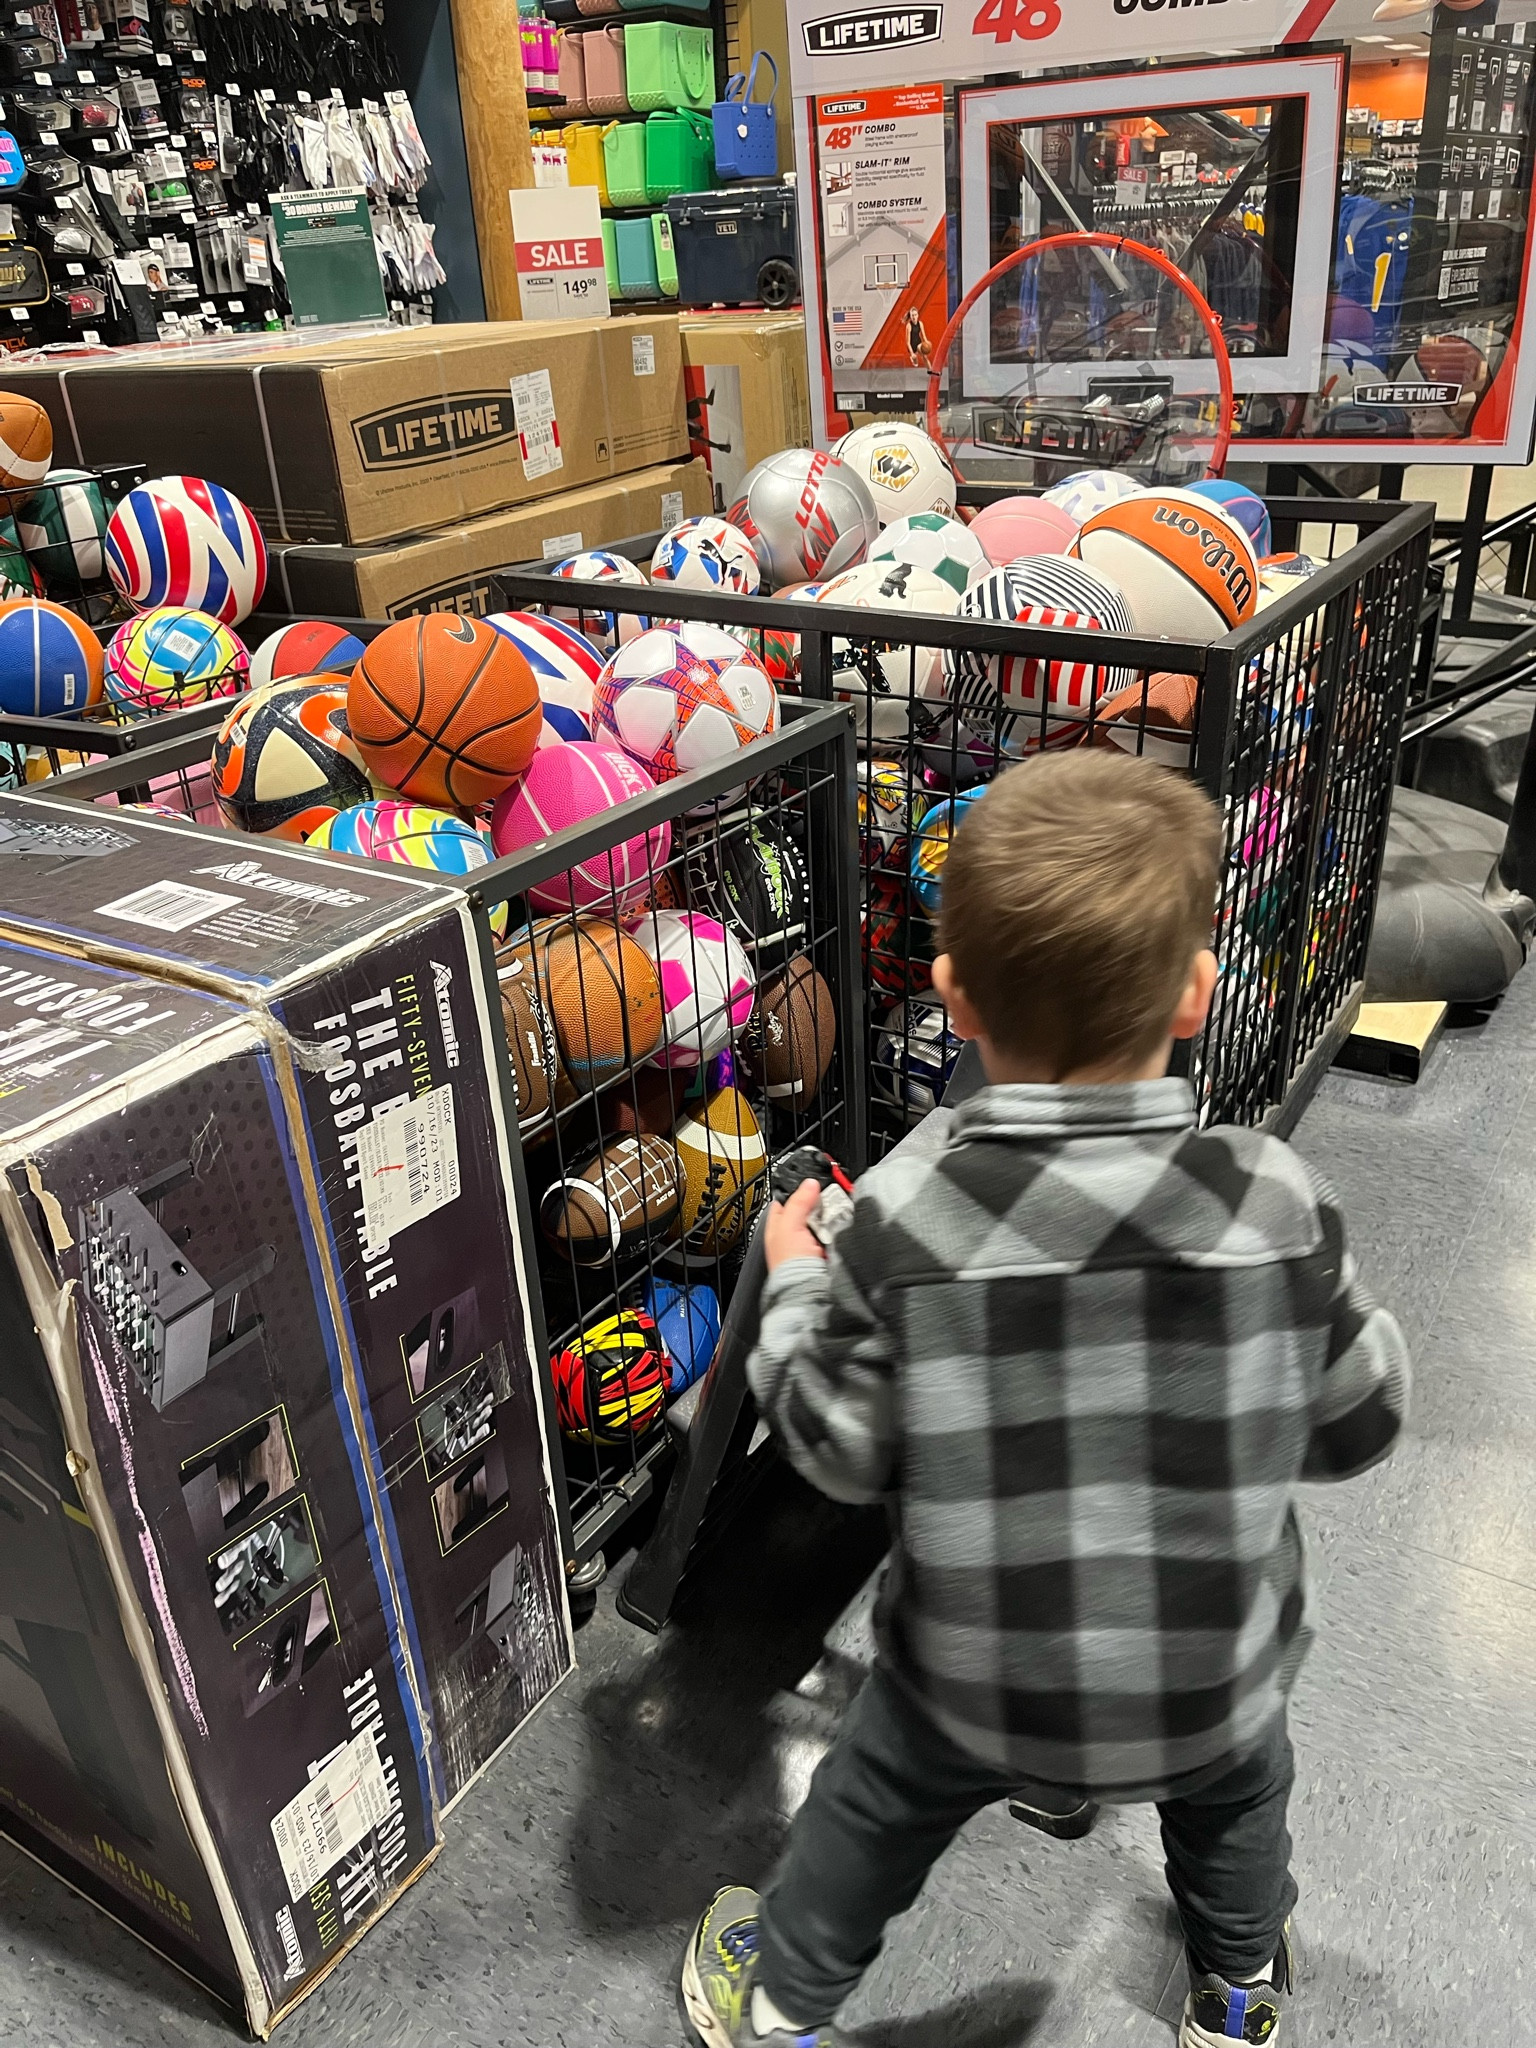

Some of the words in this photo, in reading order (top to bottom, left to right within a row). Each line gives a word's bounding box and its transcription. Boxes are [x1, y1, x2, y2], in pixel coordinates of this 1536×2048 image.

[818, 13, 926, 48] LIFETIME
[827, 102, 862, 113] LIFETIME
[865, 123, 896, 134] COMBO
[893, 156, 910, 166] RIM
[1121, 169, 1144, 182] SALE
[295, 203, 323, 215] BONUS
[857, 200, 888, 209] COMBO
[889, 197, 922, 207] SYSTEM
[718, 223, 736, 233] YETI
[530, 242, 589, 268] SALE
[1364, 386, 1448, 403] LIFETIME
[377, 403, 503, 457] LIFETIME
[794, 450, 829, 530] LOTTO
[1155, 504, 1254, 619] Wilson
[190, 860, 371, 908] Atomic
[350, 986, 404, 1079] THE
[429, 959, 460, 1069] Atomic
[426, 1094, 439, 1154] 10/16/23
[441, 1089, 452, 1125] XDOCK
[448, 1159, 459, 1196] 00024
[417, 1123, 430, 1194] 990724
[432, 1160, 444, 1204] MOD:01
[273, 1816, 289, 1848] 00024
[290, 1798, 307, 1837] MOD:01
[306, 1801, 328, 1855] 990717
[93, 1834, 192, 1922] INCLUDES
[288, 1867, 304, 1898] XDOCK
[301, 1837, 321, 1883] 10/16/23
[336, 1848, 378, 1925] THE
[307, 1877, 340, 1950] FIFTY-SEV
[275, 1903, 307, 1982] Atomic
